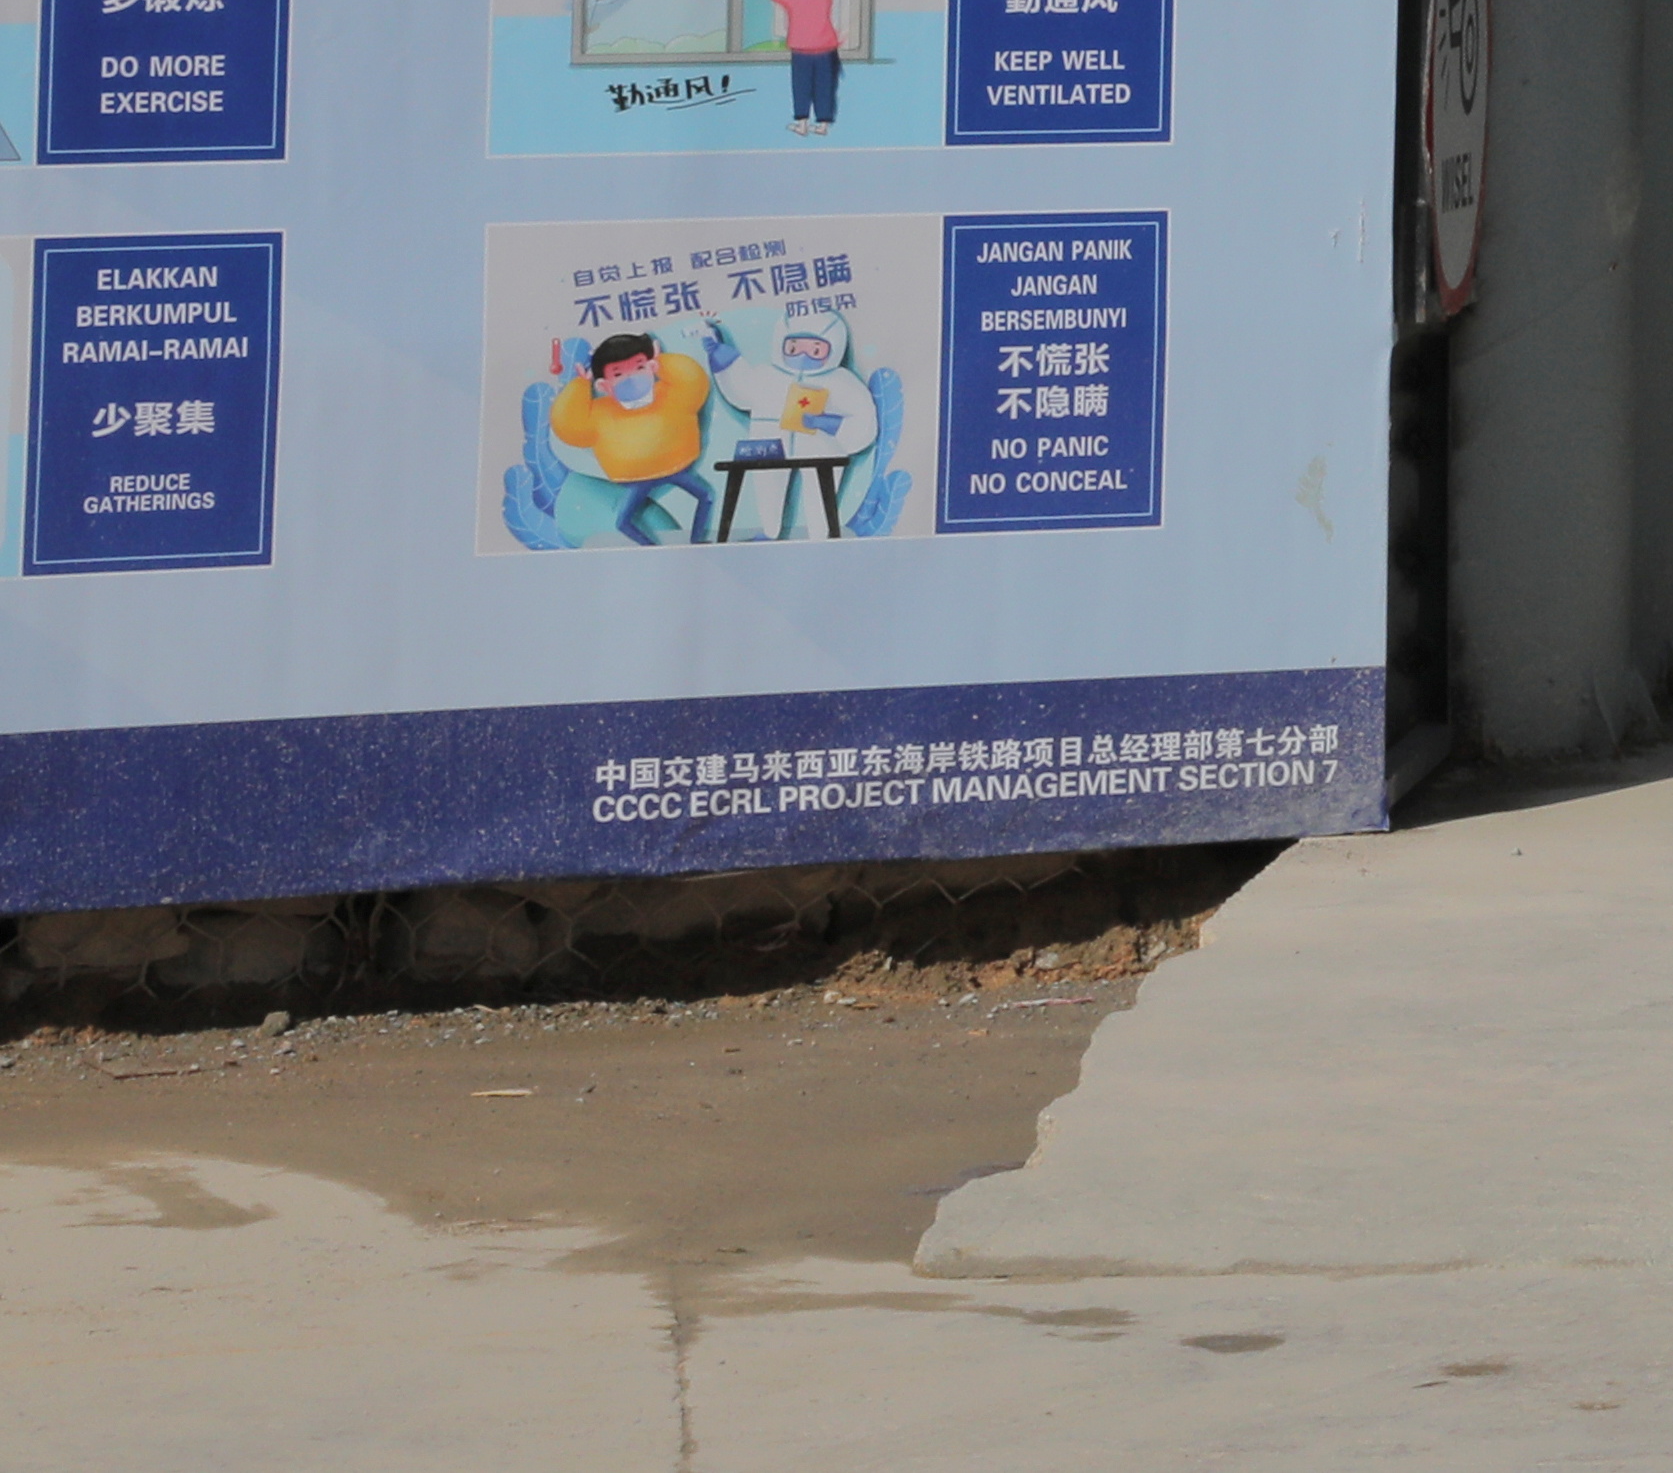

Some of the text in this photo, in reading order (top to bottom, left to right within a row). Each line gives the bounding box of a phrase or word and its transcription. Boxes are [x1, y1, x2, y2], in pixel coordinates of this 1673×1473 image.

[995, 50, 1125, 71] KEEP WELL
[987, 84, 1130, 105] VENTILATED
[1441, 153, 1474, 214] WISEL
[574, 240, 786, 287] 自觉上报 配合检测
[574, 254, 851, 327] 不慌张 不隐瞒
[786, 294, 858, 317] 防传染
[594, 723, 1340, 792] 中国交建马来西亚东海岸铁路项目总经理部第七分部
[591, 759, 1339, 823] CCCC ECRL PROJECT MANAGEMENT SECTION 7
